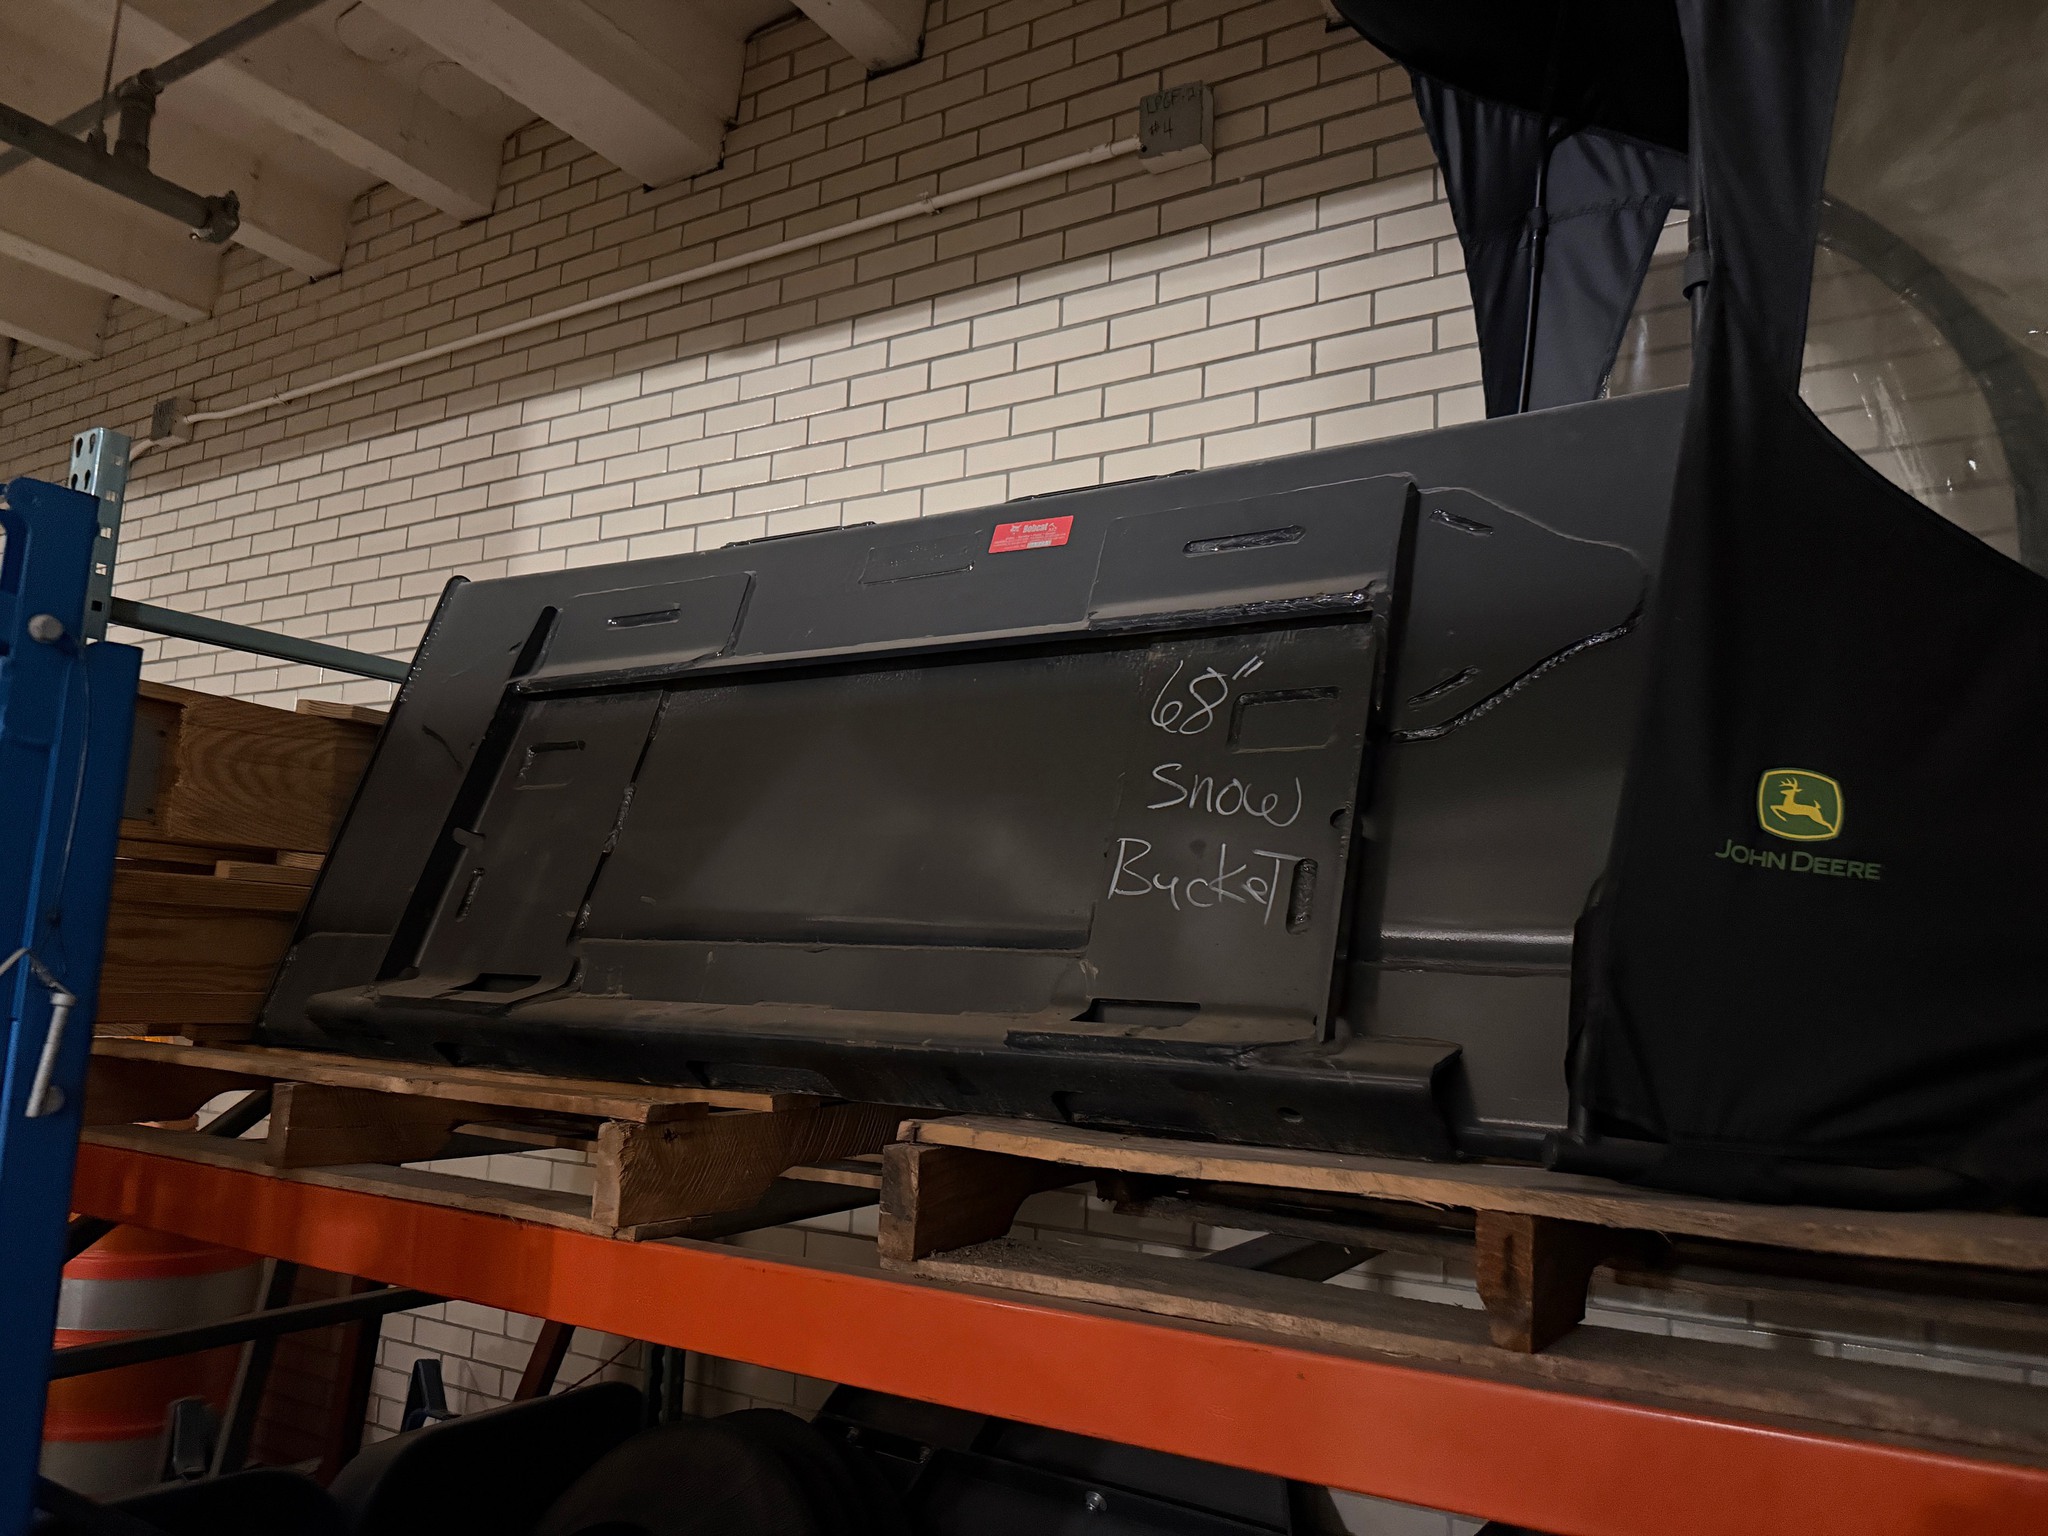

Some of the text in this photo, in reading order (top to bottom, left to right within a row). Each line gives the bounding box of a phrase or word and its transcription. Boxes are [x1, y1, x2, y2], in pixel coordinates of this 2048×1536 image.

[1023, 523, 1049, 533] Bobcat
[1151, 655, 1264, 735] 68"
[1147, 763, 1302, 827] Snow
[1715, 839, 1882, 881] JOHN DEERE
